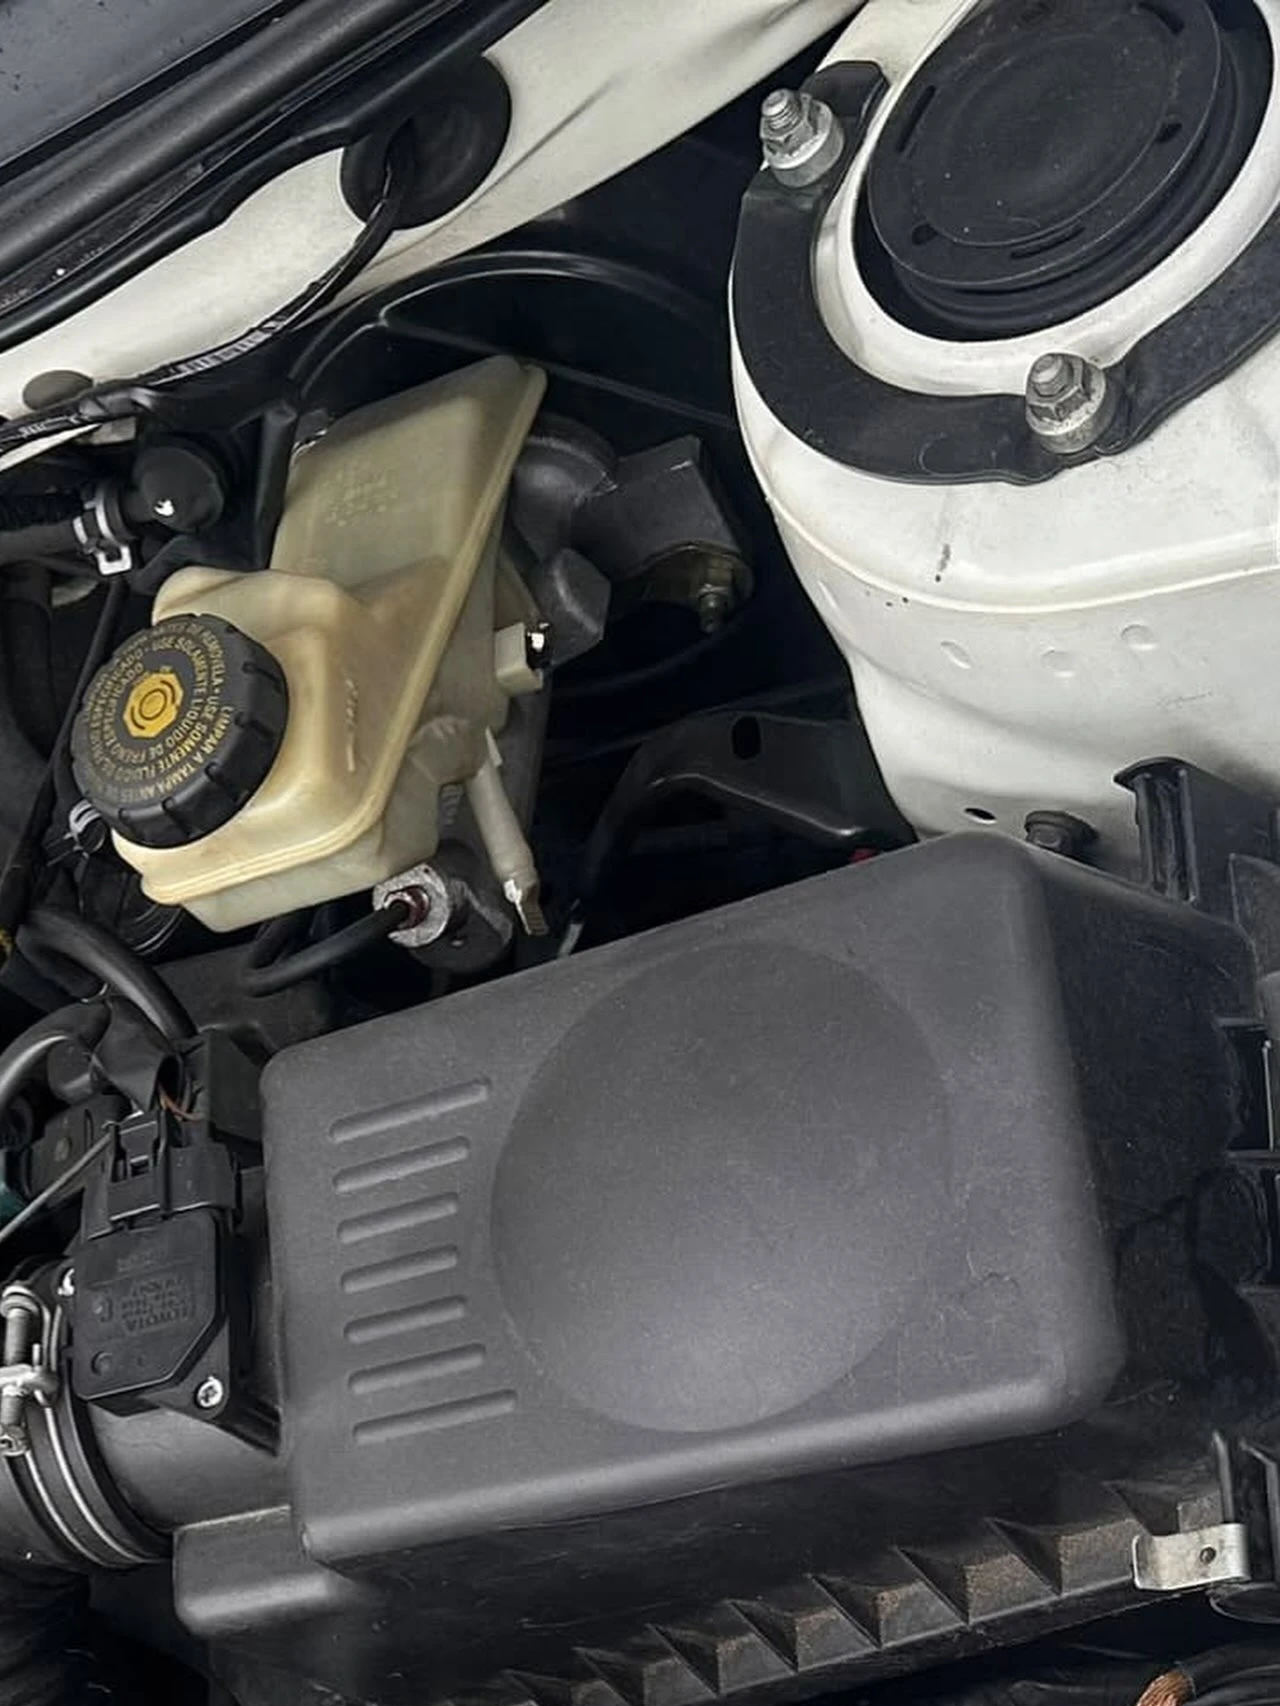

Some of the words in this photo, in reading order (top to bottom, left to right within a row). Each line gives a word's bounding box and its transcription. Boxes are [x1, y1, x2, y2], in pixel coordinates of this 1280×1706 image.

[164, 697, 204, 753] LIQUIDO
[198, 693, 222, 721] USE
[198, 705, 234, 757] LIMPAR
[155, 720, 210, 779] SOMENTE
[154, 758, 196, 797] TAMPA
